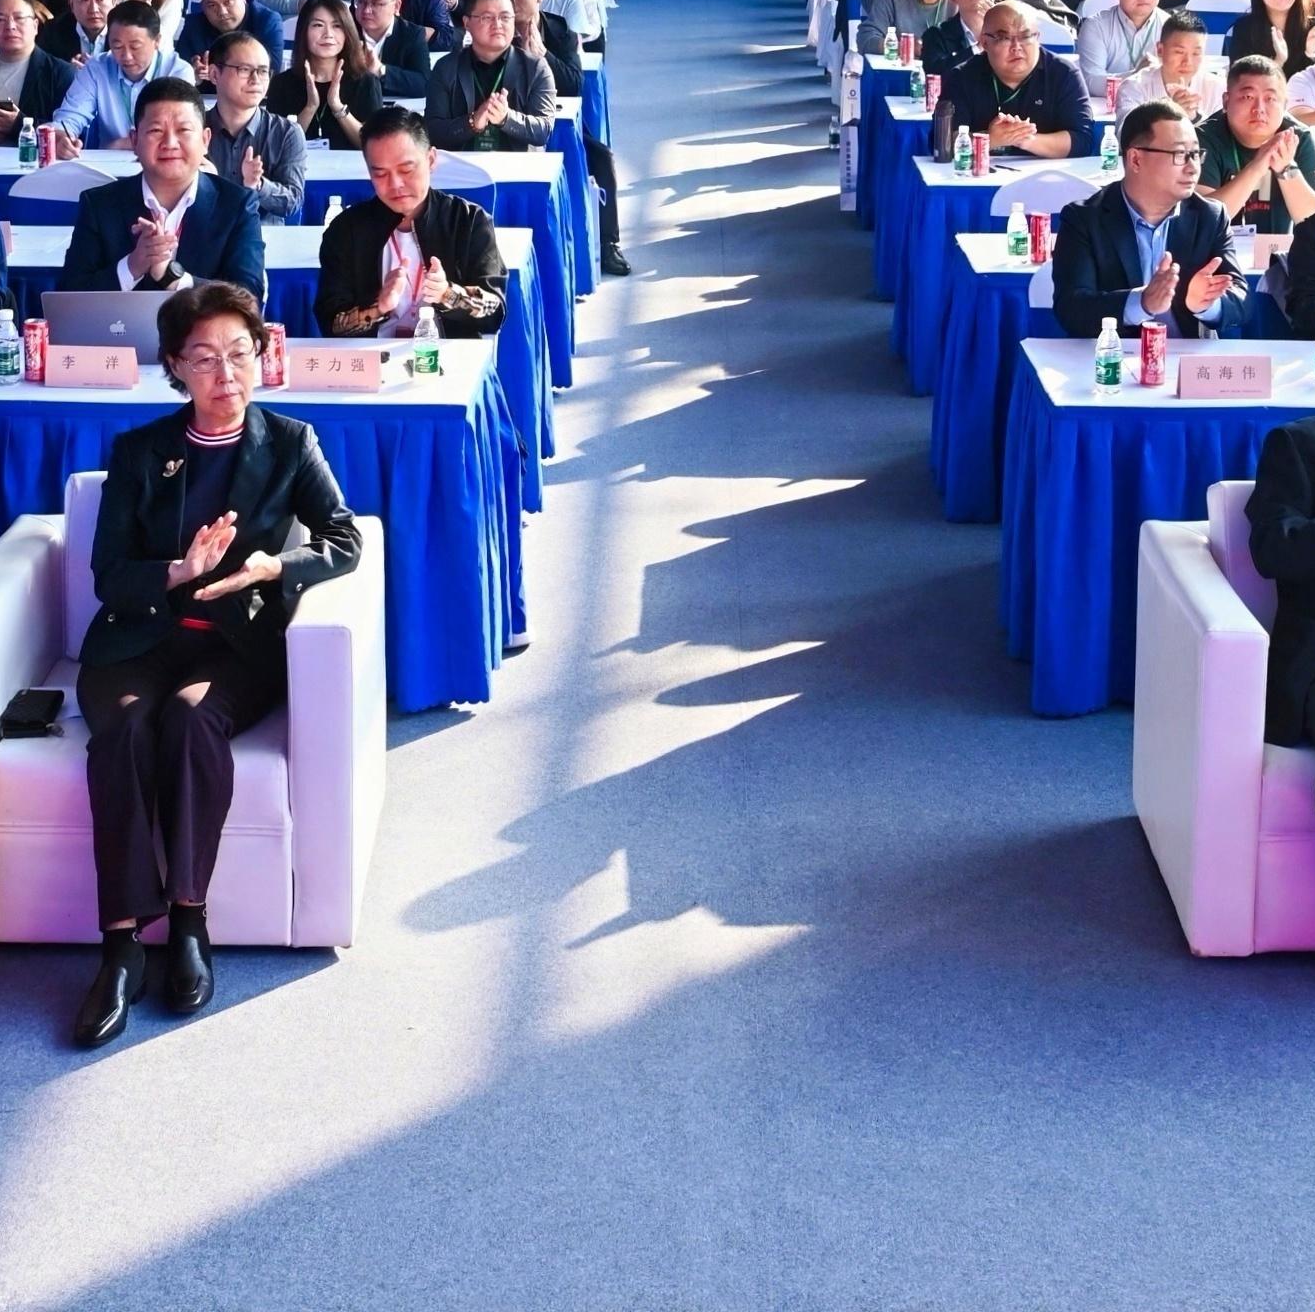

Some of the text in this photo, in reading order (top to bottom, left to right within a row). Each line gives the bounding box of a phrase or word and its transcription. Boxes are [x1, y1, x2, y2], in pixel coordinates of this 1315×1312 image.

[305, 357, 365, 372] 李力强
[1197, 365, 1256, 381] 高海伟
